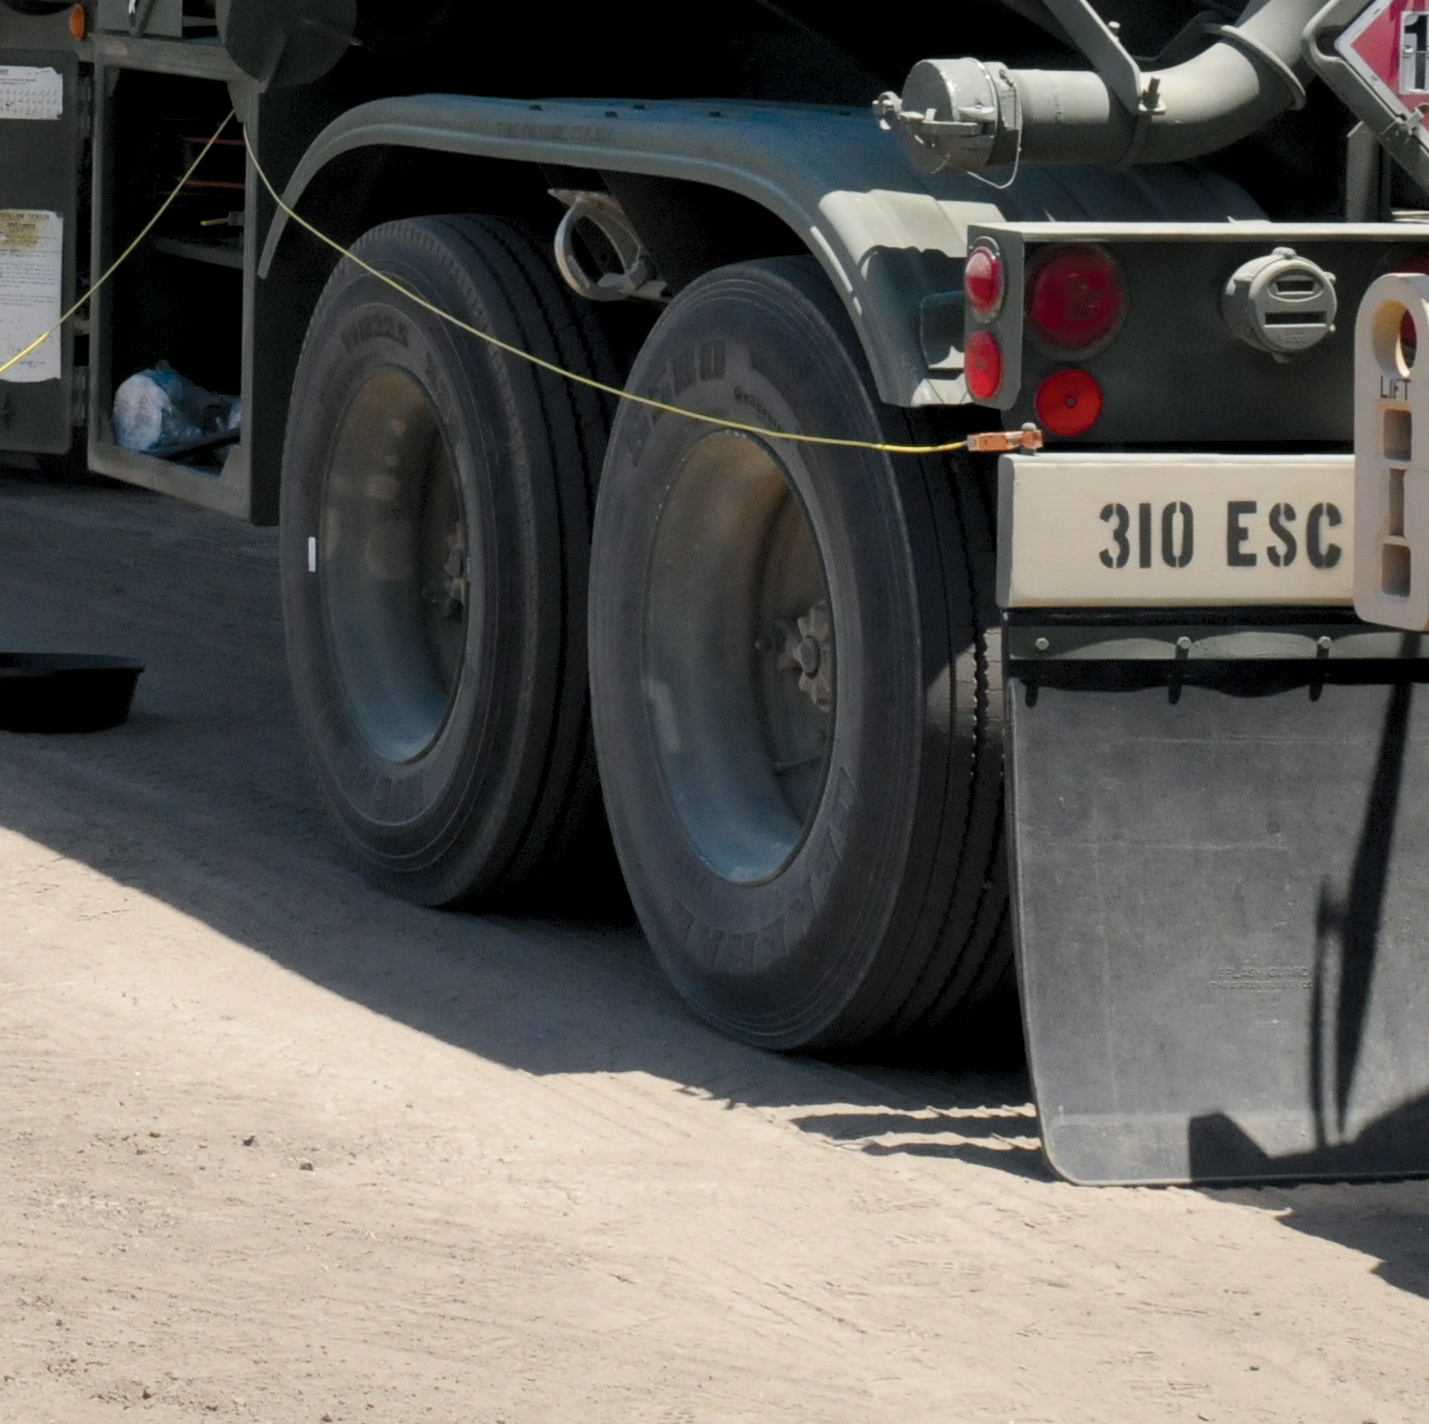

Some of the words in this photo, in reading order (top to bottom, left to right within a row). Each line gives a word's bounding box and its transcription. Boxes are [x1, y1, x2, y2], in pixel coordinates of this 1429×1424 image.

[1380, 375, 1411, 401] LIFT
[1099, 501, 1195, 570] 310
[1227, 501, 1343, 570] ESC
